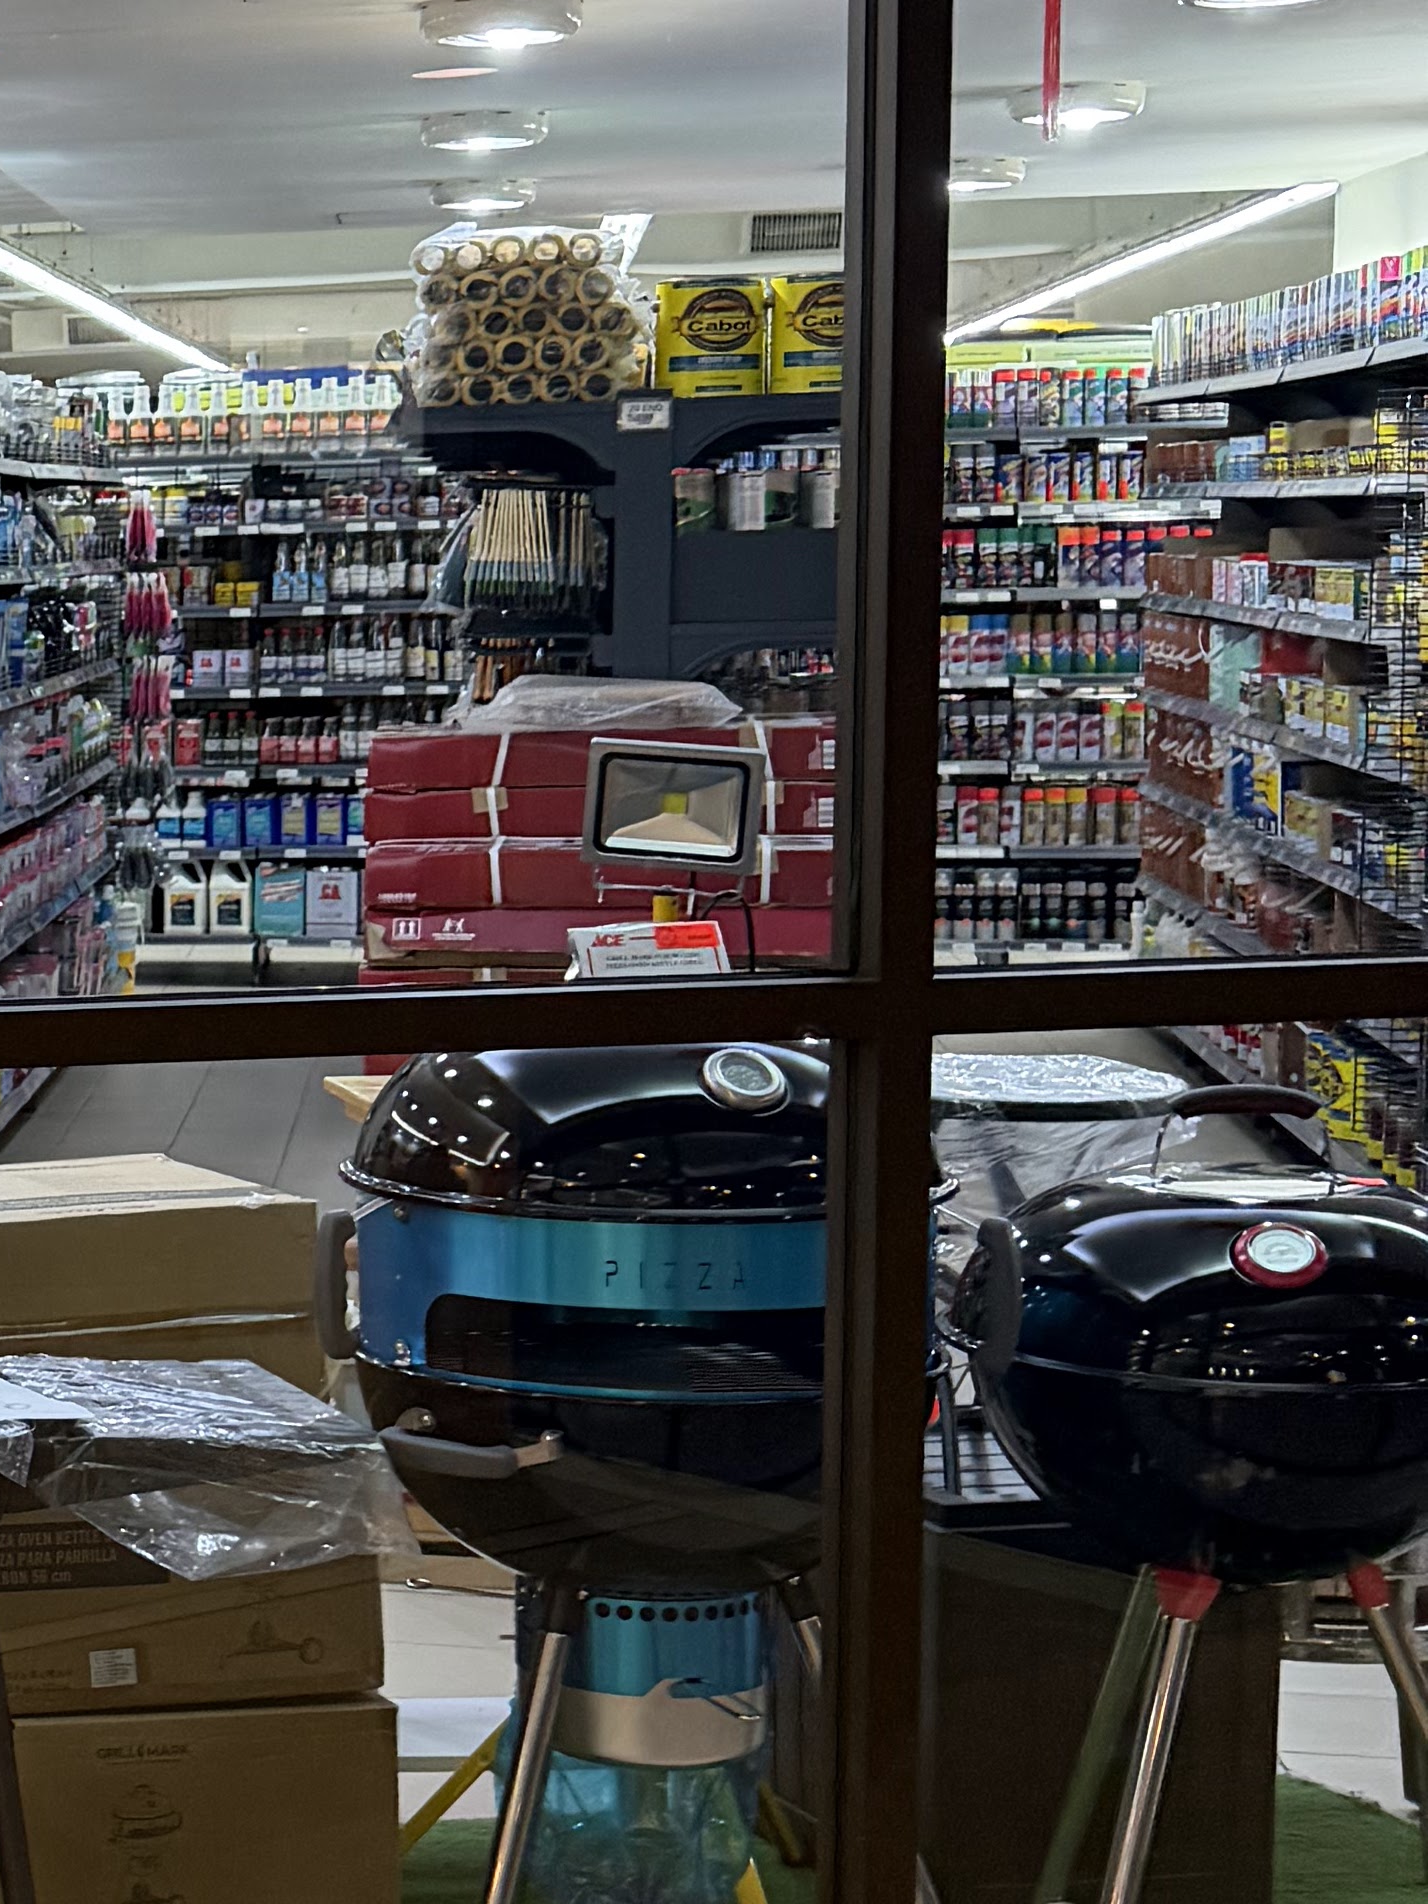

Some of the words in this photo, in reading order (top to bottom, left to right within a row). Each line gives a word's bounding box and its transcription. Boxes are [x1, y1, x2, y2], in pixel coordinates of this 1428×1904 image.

[687, 318, 751, 332] Cabot
[802, 314, 844, 328] Cab
[591, 933, 625, 947] ACE
[605, 1260, 745, 1290] PIZZA
